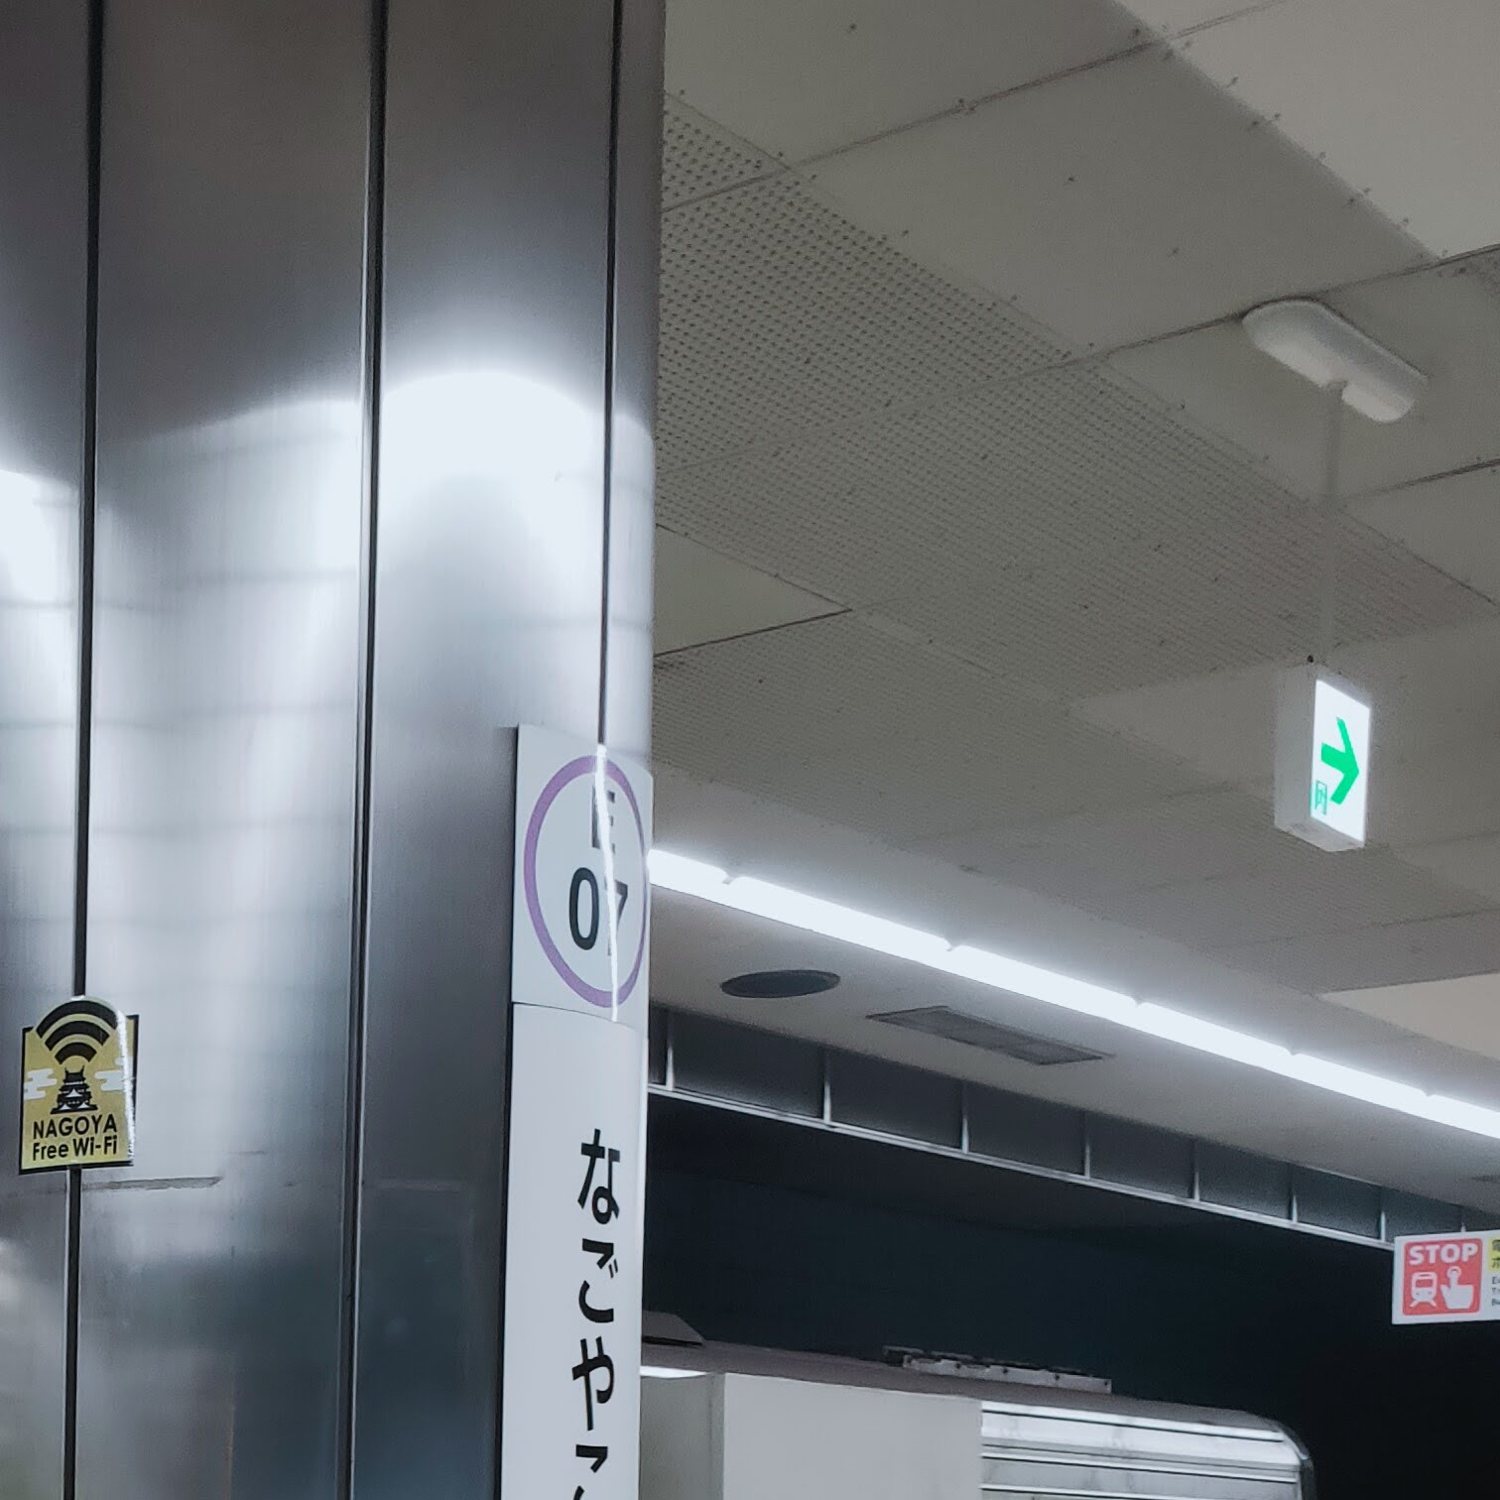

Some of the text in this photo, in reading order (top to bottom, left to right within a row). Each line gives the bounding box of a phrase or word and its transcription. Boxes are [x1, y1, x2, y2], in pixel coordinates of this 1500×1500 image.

[568, 866, 629, 957] 07
[33, 1113, 117, 1140] NAGOYA
[32, 1141, 69, 1161] Free
[72, 1134, 118, 1157] Wi-Fi
[1408, 1242, 1479, 1266] STOP
